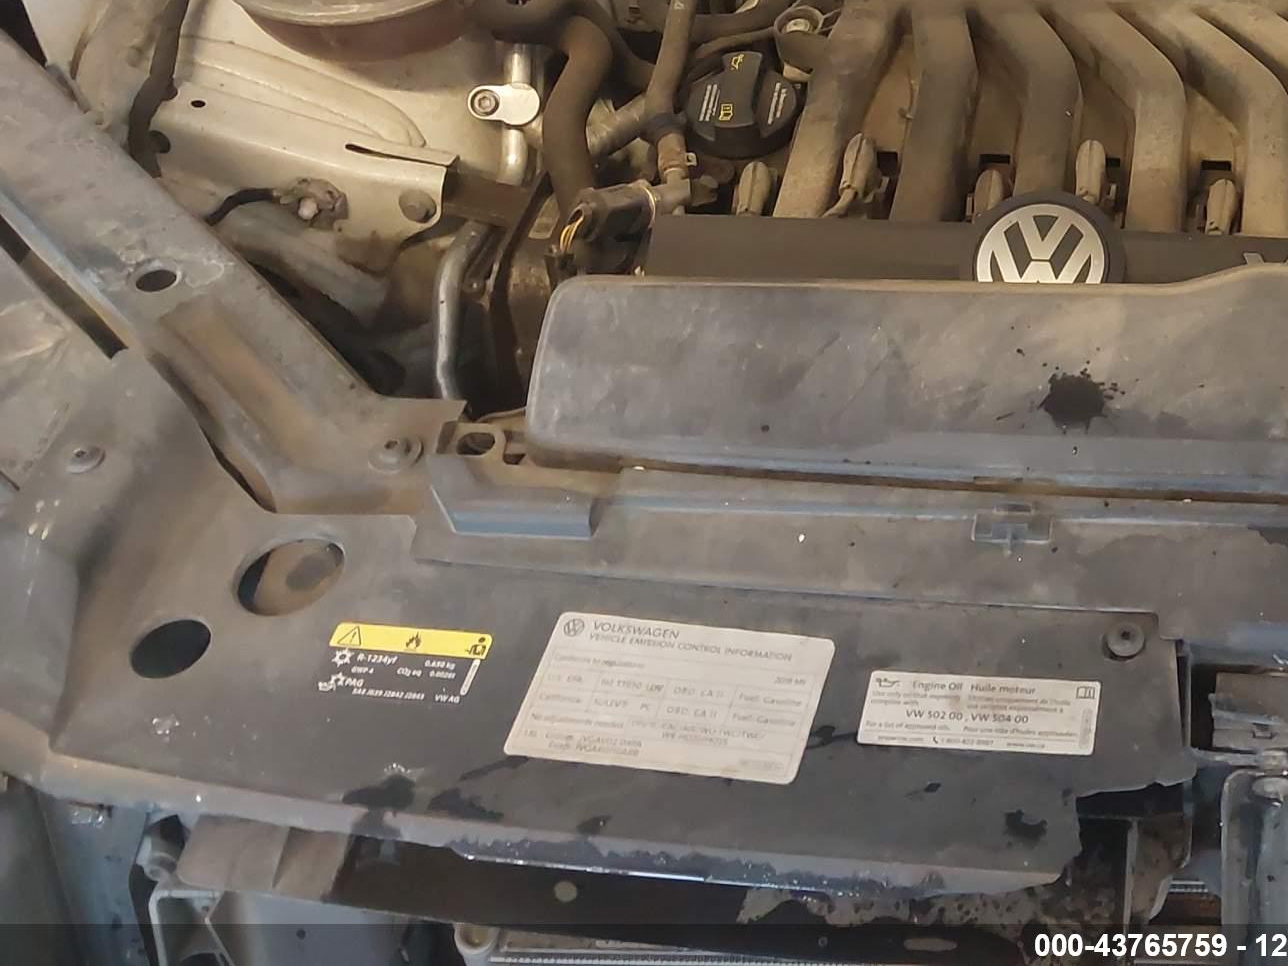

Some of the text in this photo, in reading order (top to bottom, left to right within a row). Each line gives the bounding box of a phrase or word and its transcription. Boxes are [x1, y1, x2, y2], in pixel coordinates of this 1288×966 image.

[593, 621, 680, 640] VOLKSWAGEN
[589, 633, 793, 661] VEHICLE EMISSION CONTROL INFORMATION
[356, 653, 398, 666] R-1234yf
[344, 678, 364, 688] PAG
[912, 679, 963, 692] Engine Oil
[970, 683, 1035, 695] Huile moteur
[905, 710, 925, 719] VW
[927, 710, 946, 720] 502
[970, 712, 1029, 724] VW 504 00
